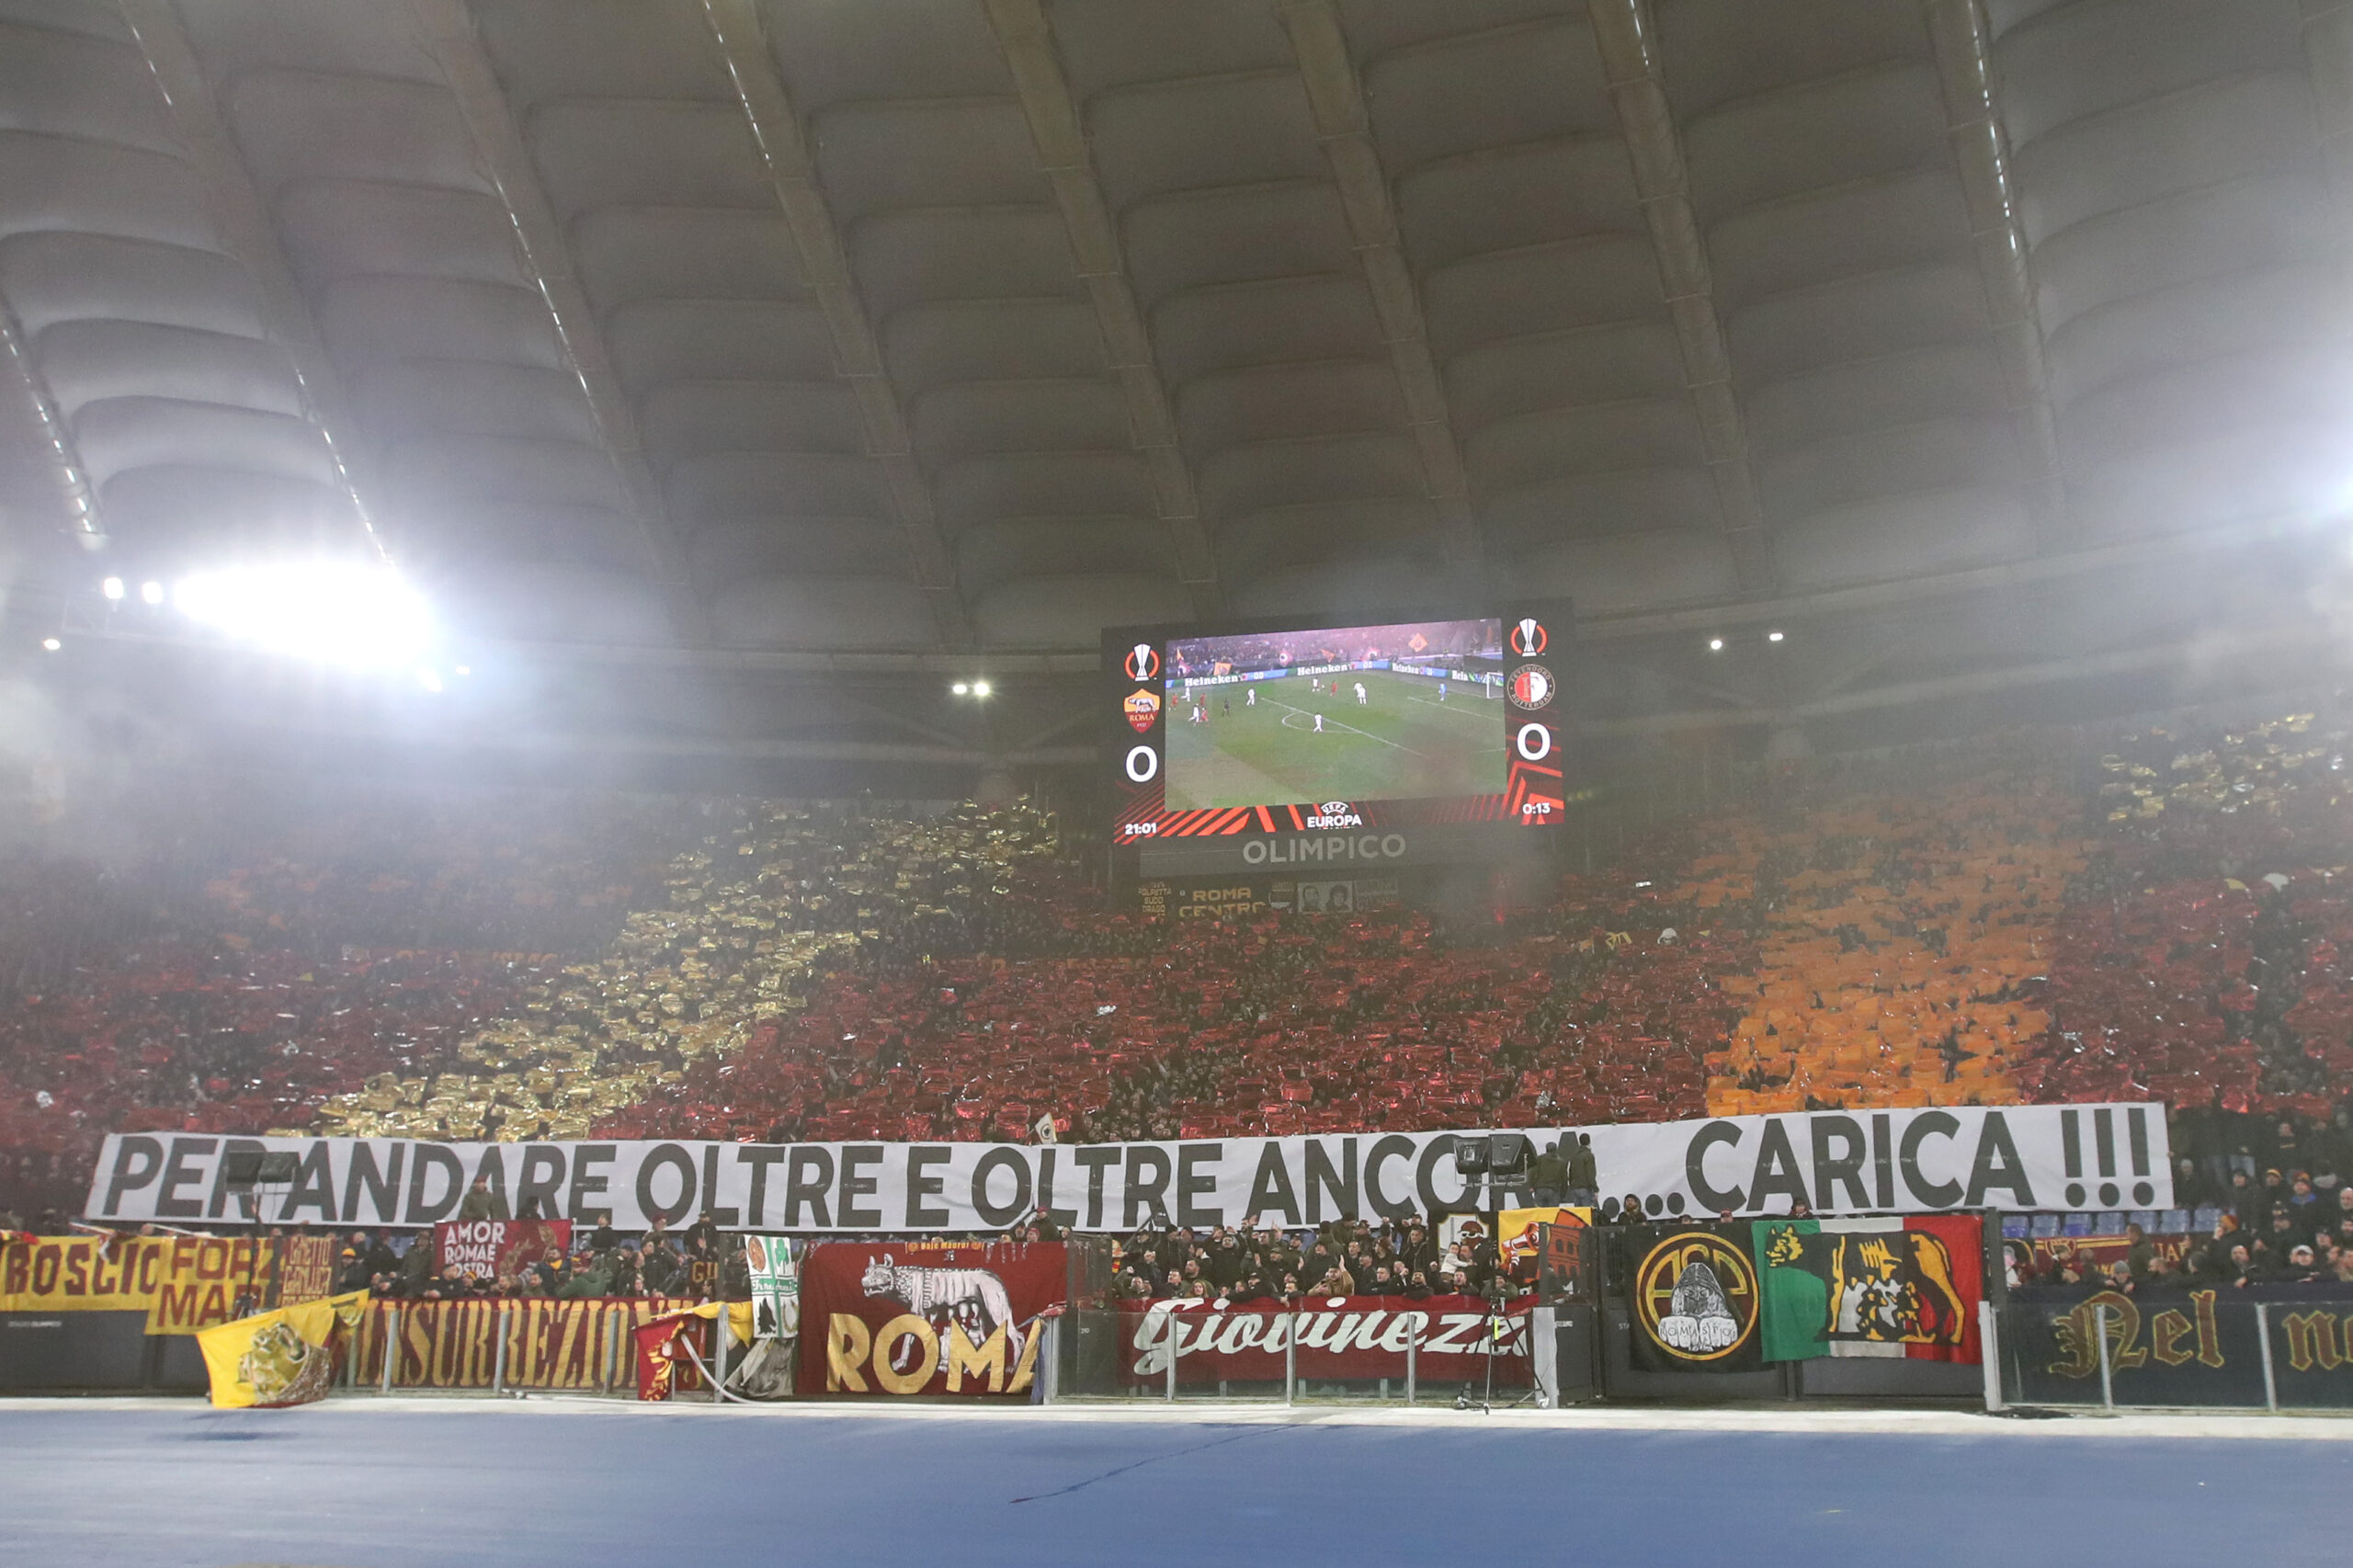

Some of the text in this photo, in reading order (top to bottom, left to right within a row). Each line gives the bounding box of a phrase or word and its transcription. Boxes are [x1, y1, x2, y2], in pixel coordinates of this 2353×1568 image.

[1297, 662, 1347, 676] Heineken
[1184, 674, 1238, 687] Heineken
[1129, 713, 1155, 722] ROMA
[1517, 722, 1551, 761] 0
[1125, 745, 1158, 782] 0
[1322, 803, 1346, 813] UEFA
[1522, 802, 1551, 815] 0:13
[1125, 823, 1157, 835] 21:01
[1307, 814, 1362, 828] EUROPA
[1243, 834, 1406, 864] OLIMPICO
[1192, 887, 1252, 902] ROMA
[102, 1135, 267, 1220] PER
[279, 1141, 617, 1225] ANDARE
[635, 1143, 884, 1227] OLTRE
[905, 1145, 951, 1227] E
[971, 1143, 1223, 1229] OLTRE
[445, 1221, 505, 1244] AMOR
[445, 1244, 496, 1265] ROMAE
[449, 1262, 494, 1279] OSTRA
[357, 1298, 695, 1388] INSURREZIO
[2049, 1290, 2224, 1379] Nel
